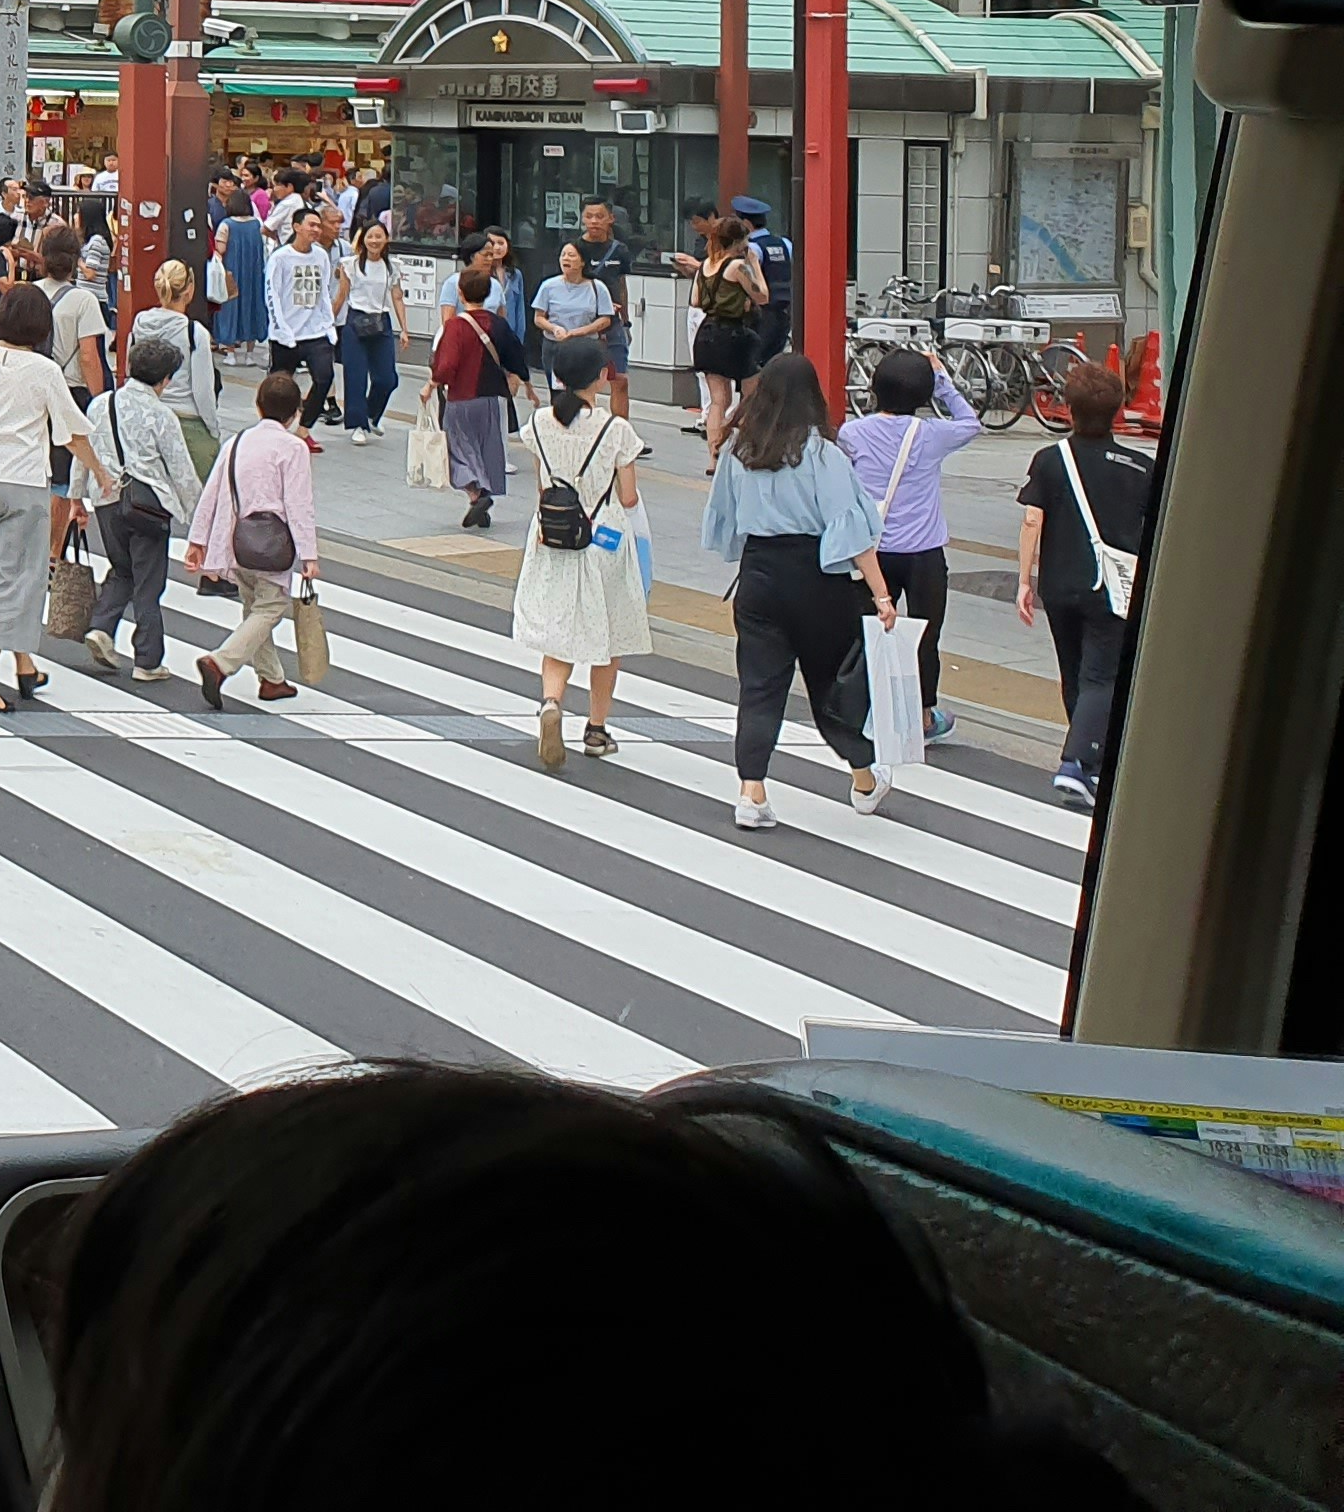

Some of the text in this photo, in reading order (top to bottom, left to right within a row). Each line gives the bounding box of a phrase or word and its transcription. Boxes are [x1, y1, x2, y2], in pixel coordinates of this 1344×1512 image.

[489, 74, 558, 97] 雷門交番
[475, 110, 583, 124] KAMINARIMON KOBAN
